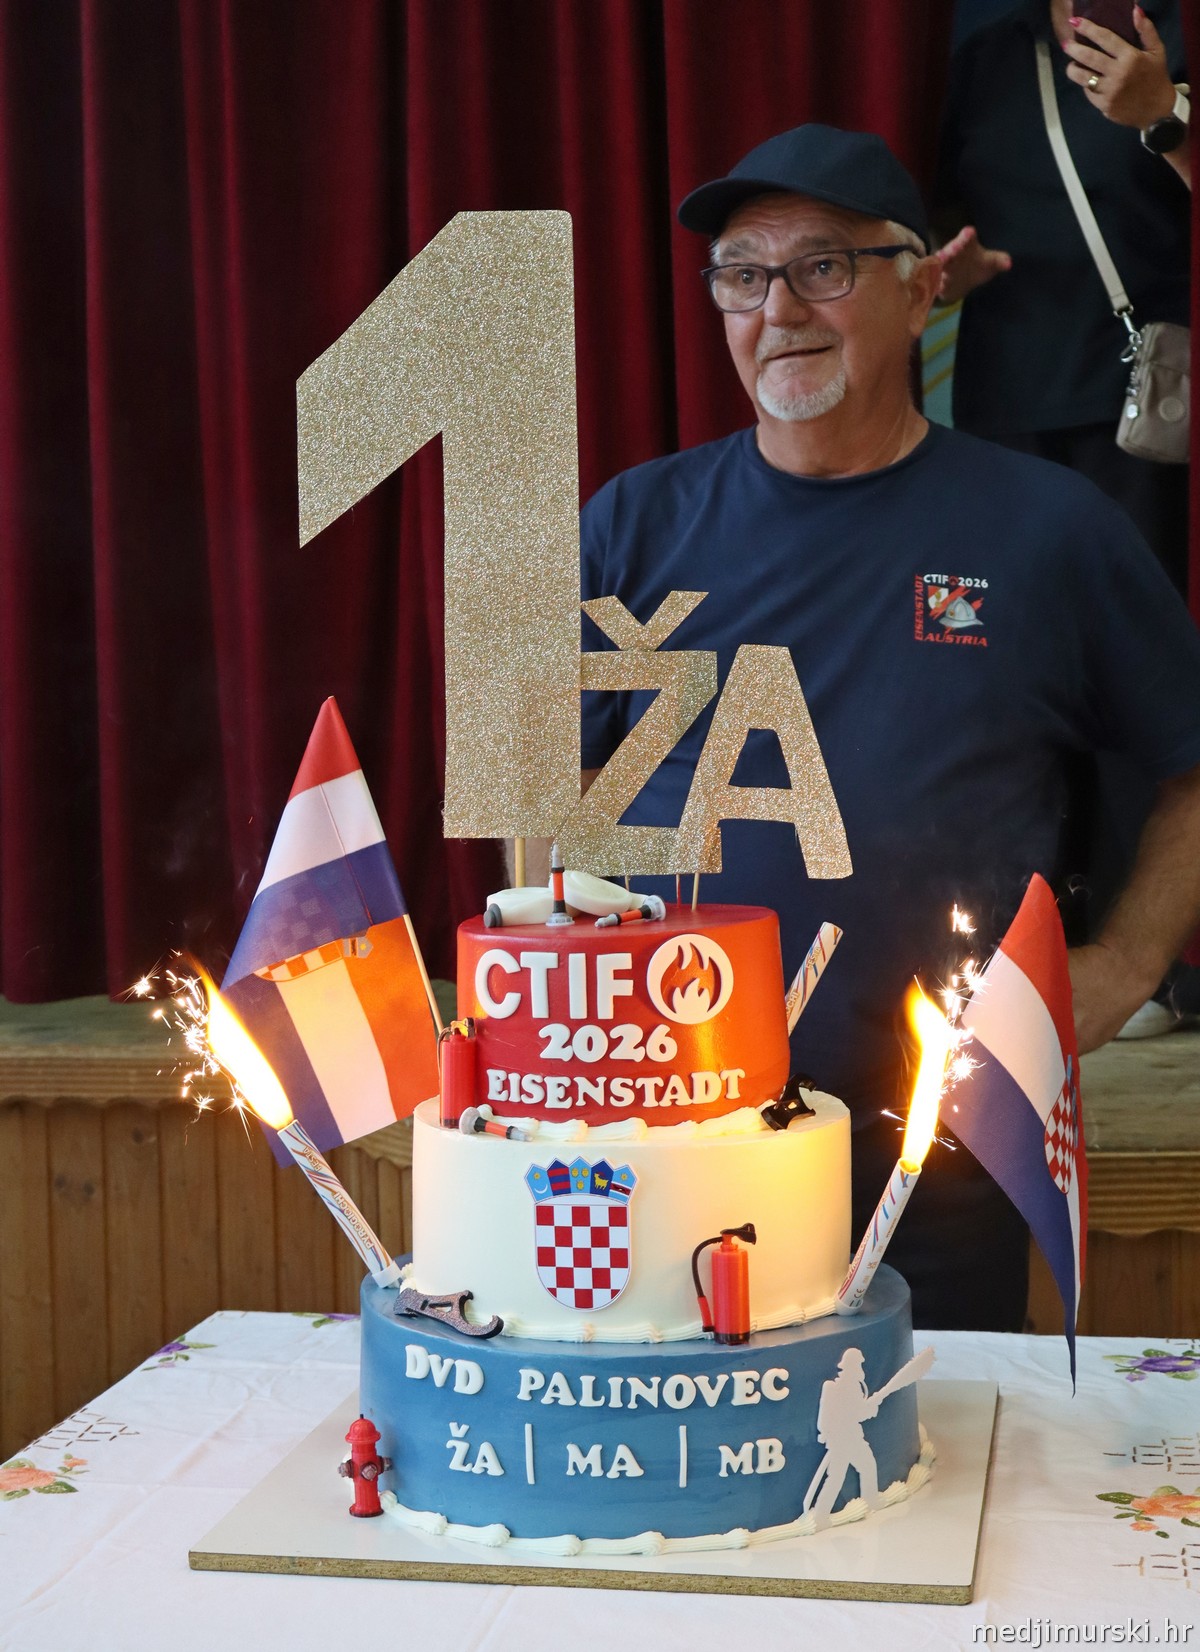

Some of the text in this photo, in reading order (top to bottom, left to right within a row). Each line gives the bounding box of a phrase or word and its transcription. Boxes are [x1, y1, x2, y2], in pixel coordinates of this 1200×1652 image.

[296, 210, 582, 838] 1
[923, 574, 988, 588] CTIF 2026
[924, 633, 987, 646] AUSTRIA
[550, 590, 853, 880] ŽA
[475, 949, 634, 1020] CTIF
[539, 1023, 678, 1063] 2026
[486, 1068, 746, 1109] EISENSTADT
[334, 1191, 375, 1250] PYROGIOCHI
[517, 1367, 790, 1410] PALINOVEC
[446, 1421, 787, 1479] ŽA MA MB
